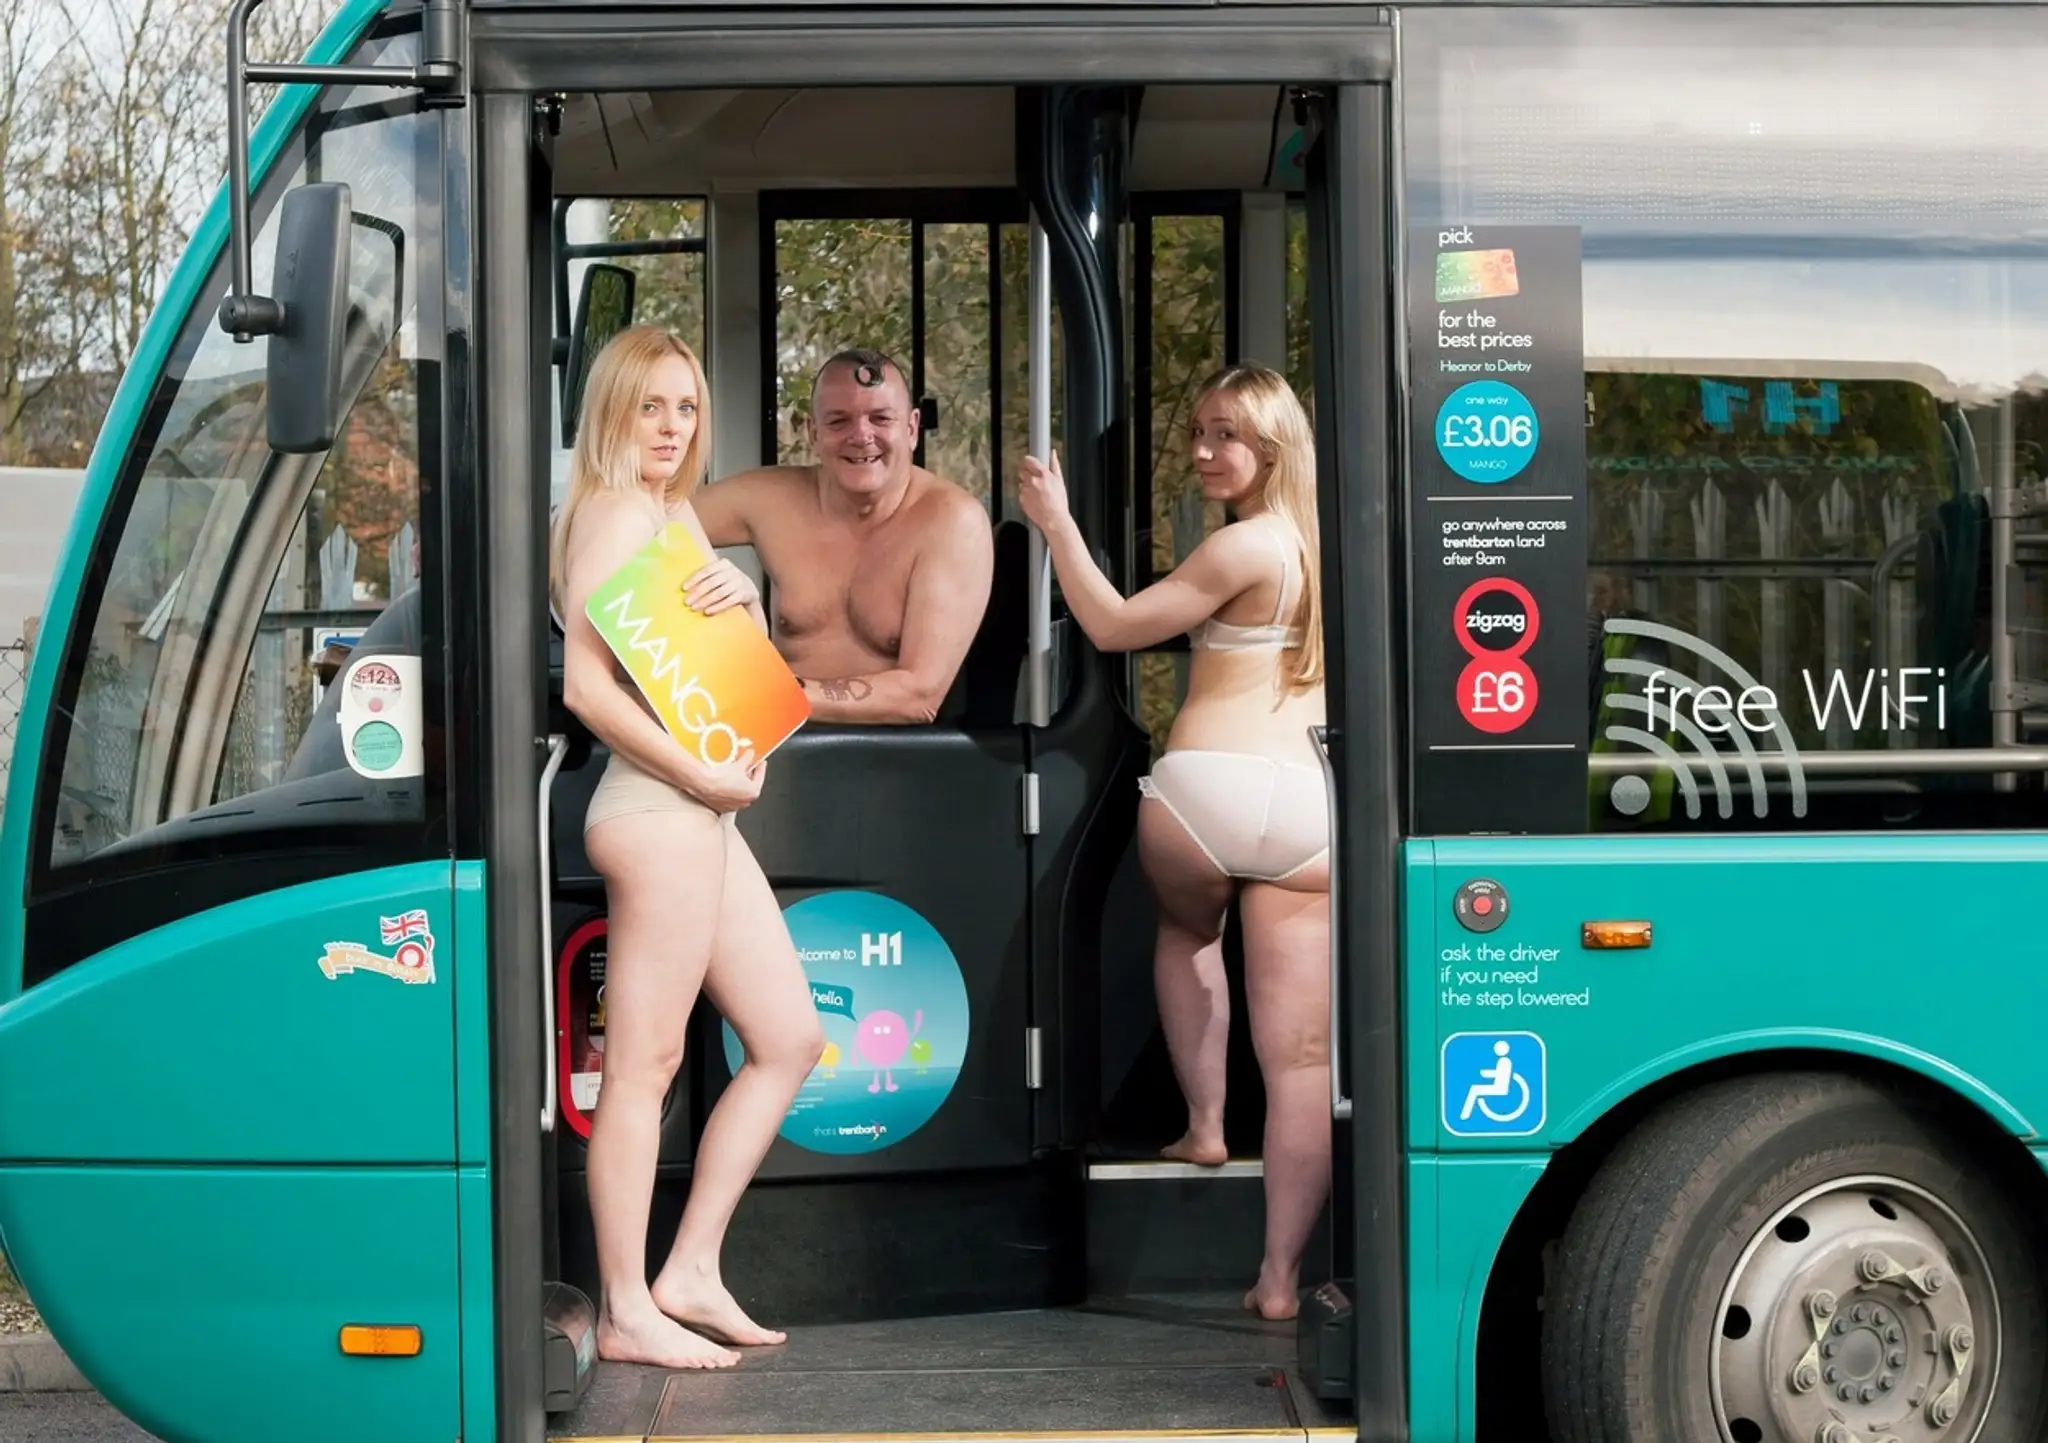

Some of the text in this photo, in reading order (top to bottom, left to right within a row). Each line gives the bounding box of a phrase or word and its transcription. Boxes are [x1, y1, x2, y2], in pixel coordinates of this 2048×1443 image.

[1438, 225, 1474, 247] pick
[1438, 310, 1496, 328] for the
[1438, 331, 1533, 351] best prices
[1440, 360, 1532, 373] Heanor to Derby
[1465, 397, 1509, 407] one way
[1443, 415, 1532, 447] £3.06
[1469, 460, 1508, 470] MANGO
[1442, 518, 1567, 533] go anywhere across
[1443, 535, 1545, 549] trentbarton land
[1443, 551, 1506, 565] after 9am
[1466, 610, 1525, 633] zigzag
[604, 588, 740, 768] MANGO
[1471, 671, 1525, 713] £6
[1643, 667, 1946, 733] free WiFi
[796, 930, 902, 967] elcome to H1
[1442, 943, 1560, 962] ask the driver
[1441, 966, 1538, 986] if you need
[1442, 988, 1590, 1009] the step lowered
